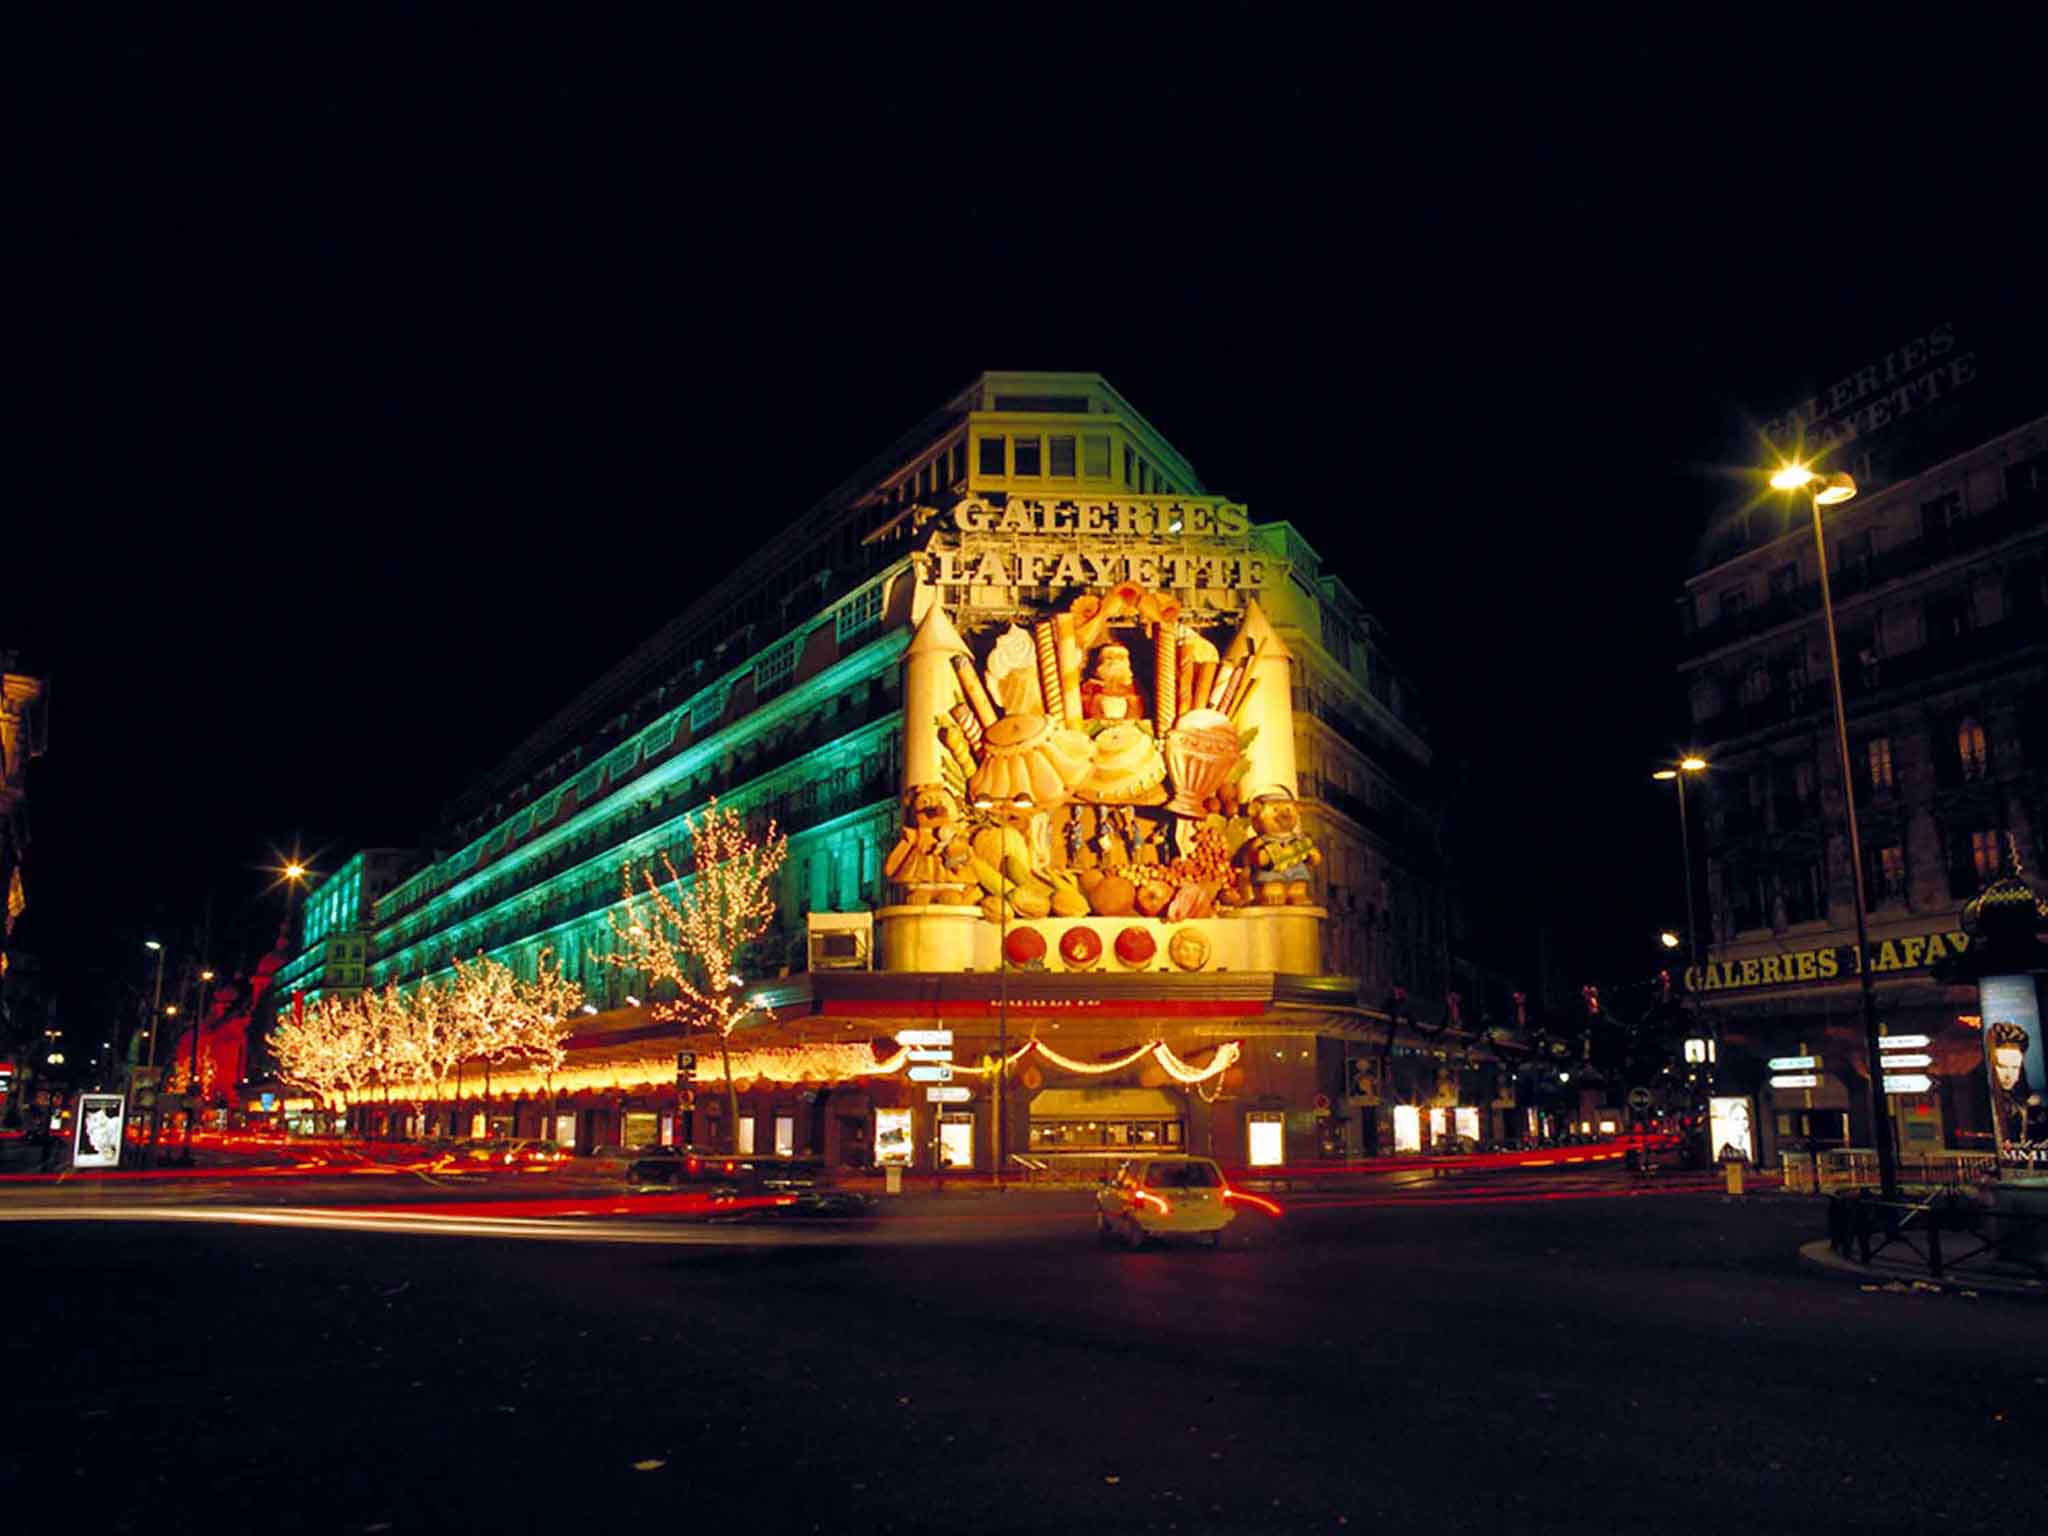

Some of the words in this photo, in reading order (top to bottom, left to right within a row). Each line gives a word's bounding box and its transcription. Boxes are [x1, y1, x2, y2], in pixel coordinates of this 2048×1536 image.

[954, 498, 1249, 536] GALERIES
[935, 551, 1271, 589] LAFAYETTE
[1683, 946, 1840, 992] GALERIES
